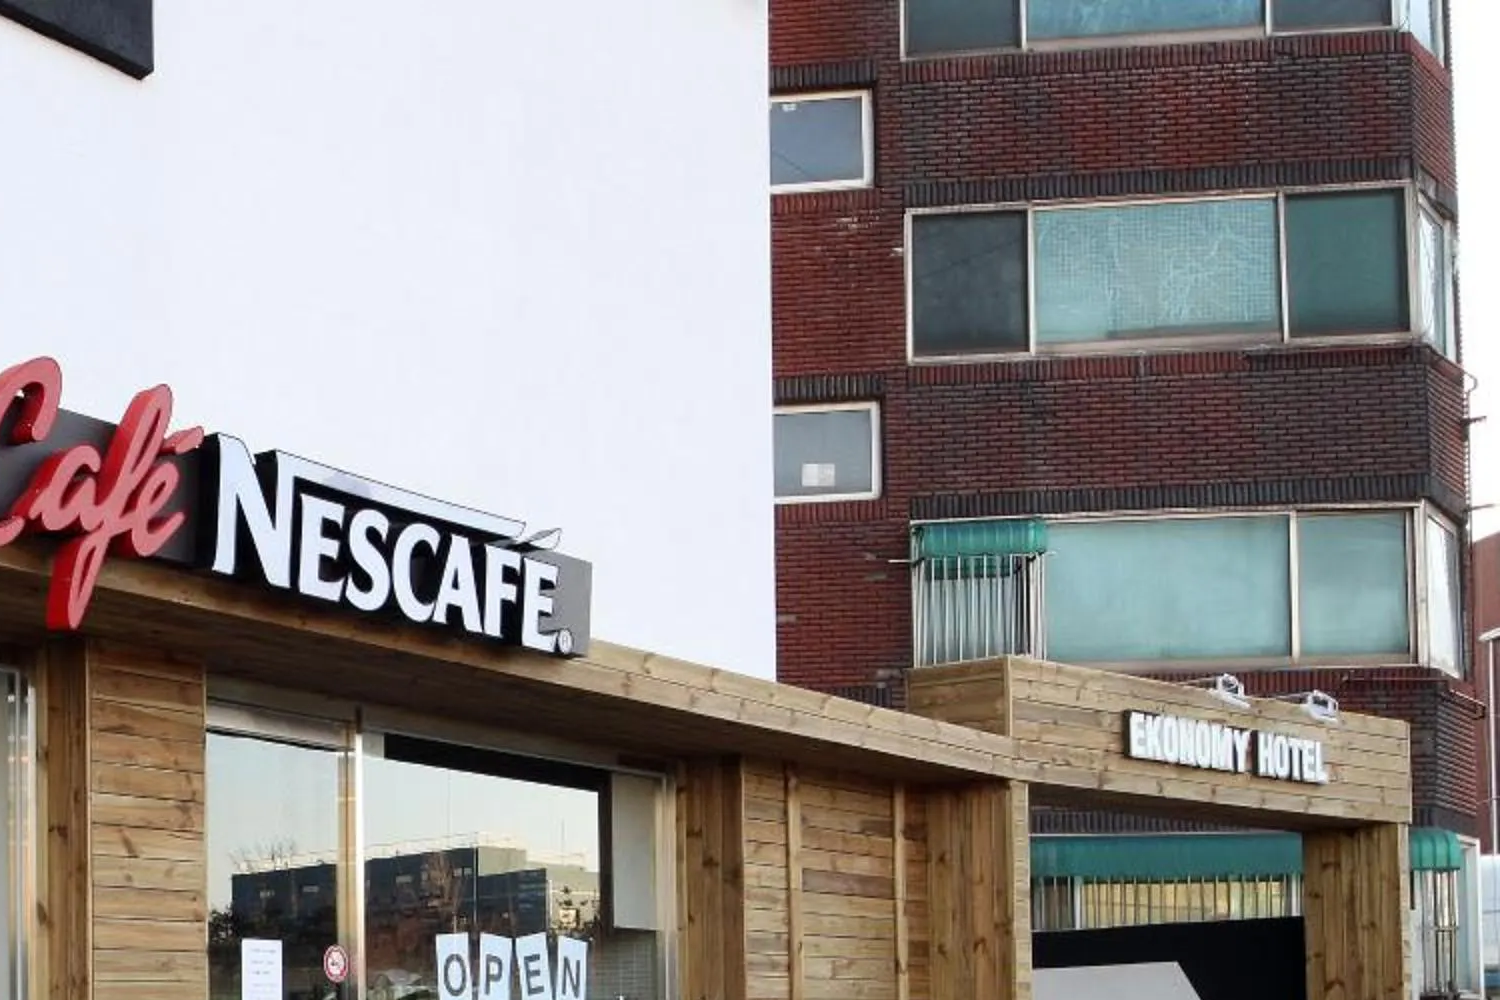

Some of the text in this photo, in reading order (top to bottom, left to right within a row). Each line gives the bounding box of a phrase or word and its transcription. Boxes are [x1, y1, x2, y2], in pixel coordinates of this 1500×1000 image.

[1127, 711, 1329, 785] EKONOMY HOTEL
[443, 953, 581, 999] OPEN
